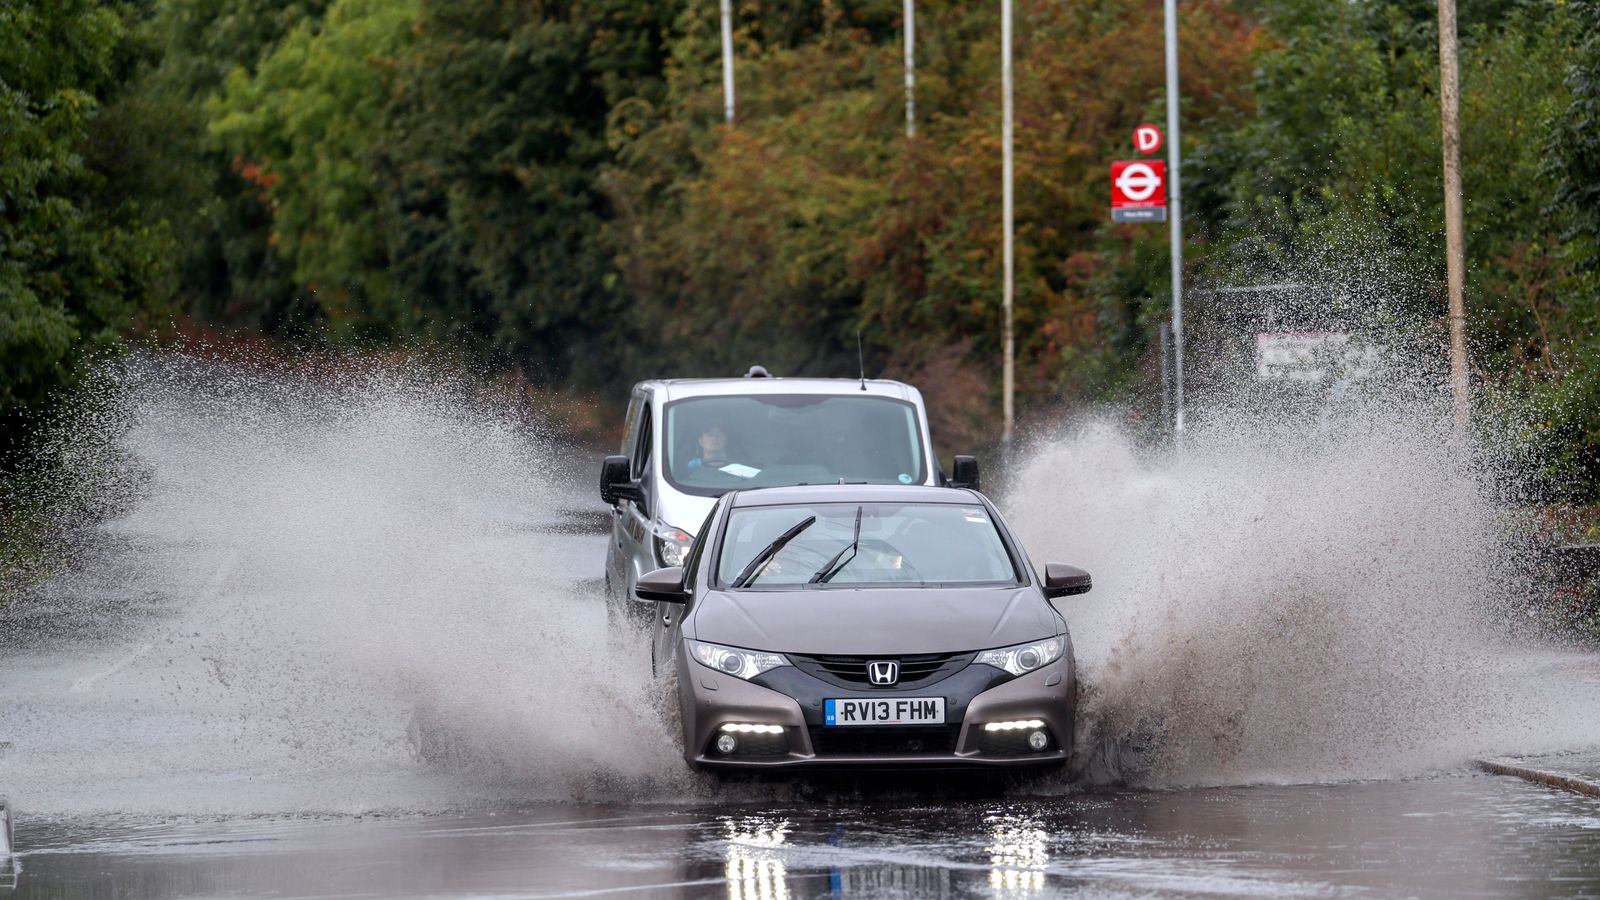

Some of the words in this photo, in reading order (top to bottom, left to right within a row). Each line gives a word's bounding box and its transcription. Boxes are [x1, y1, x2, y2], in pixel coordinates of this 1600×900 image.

[1138, 127, 1158, 150] D
[844, 702, 890, 721] RV13
[896, 700, 936, 719] FHM
